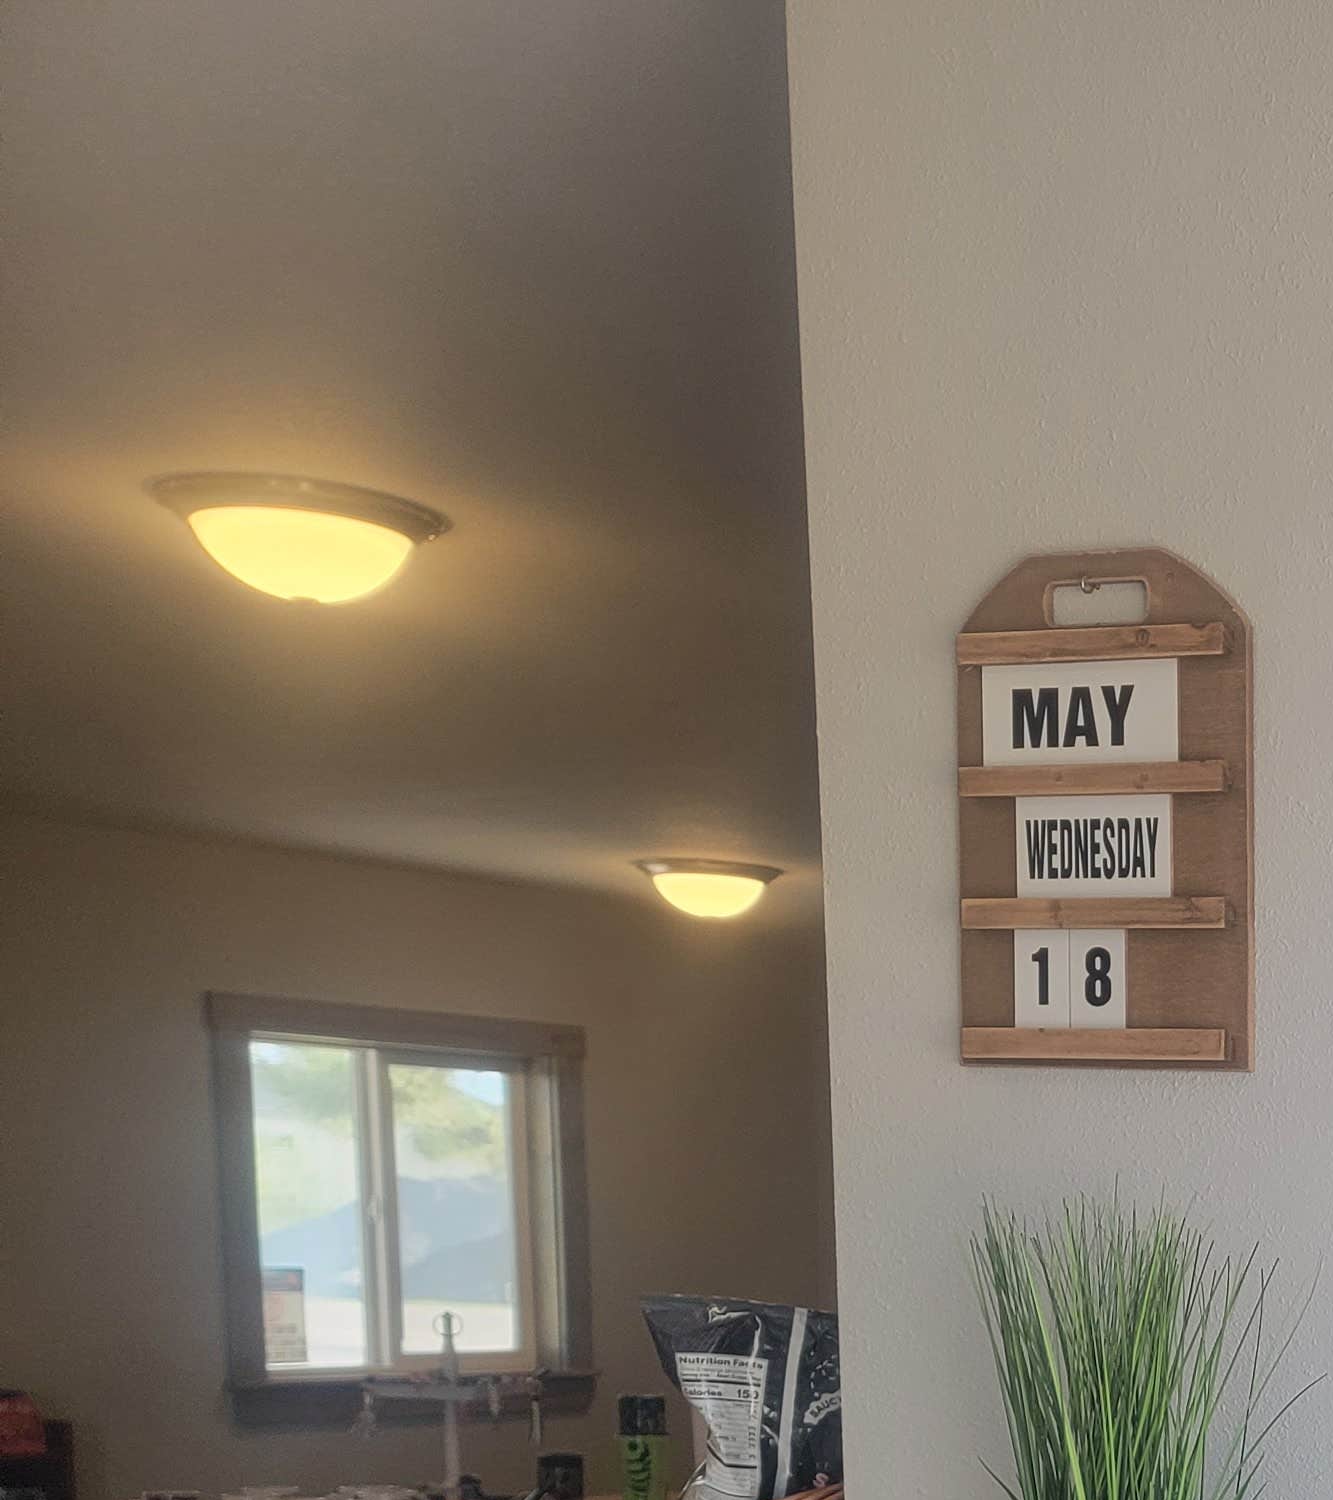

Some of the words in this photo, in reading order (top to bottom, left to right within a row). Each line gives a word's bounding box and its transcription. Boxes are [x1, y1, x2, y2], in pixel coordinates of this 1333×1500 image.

[1011, 684, 1135, 749] MAY
[1025, 816, 1159, 880] WEDNESDAY
[679, 1356, 731, 1366] Nutrition
